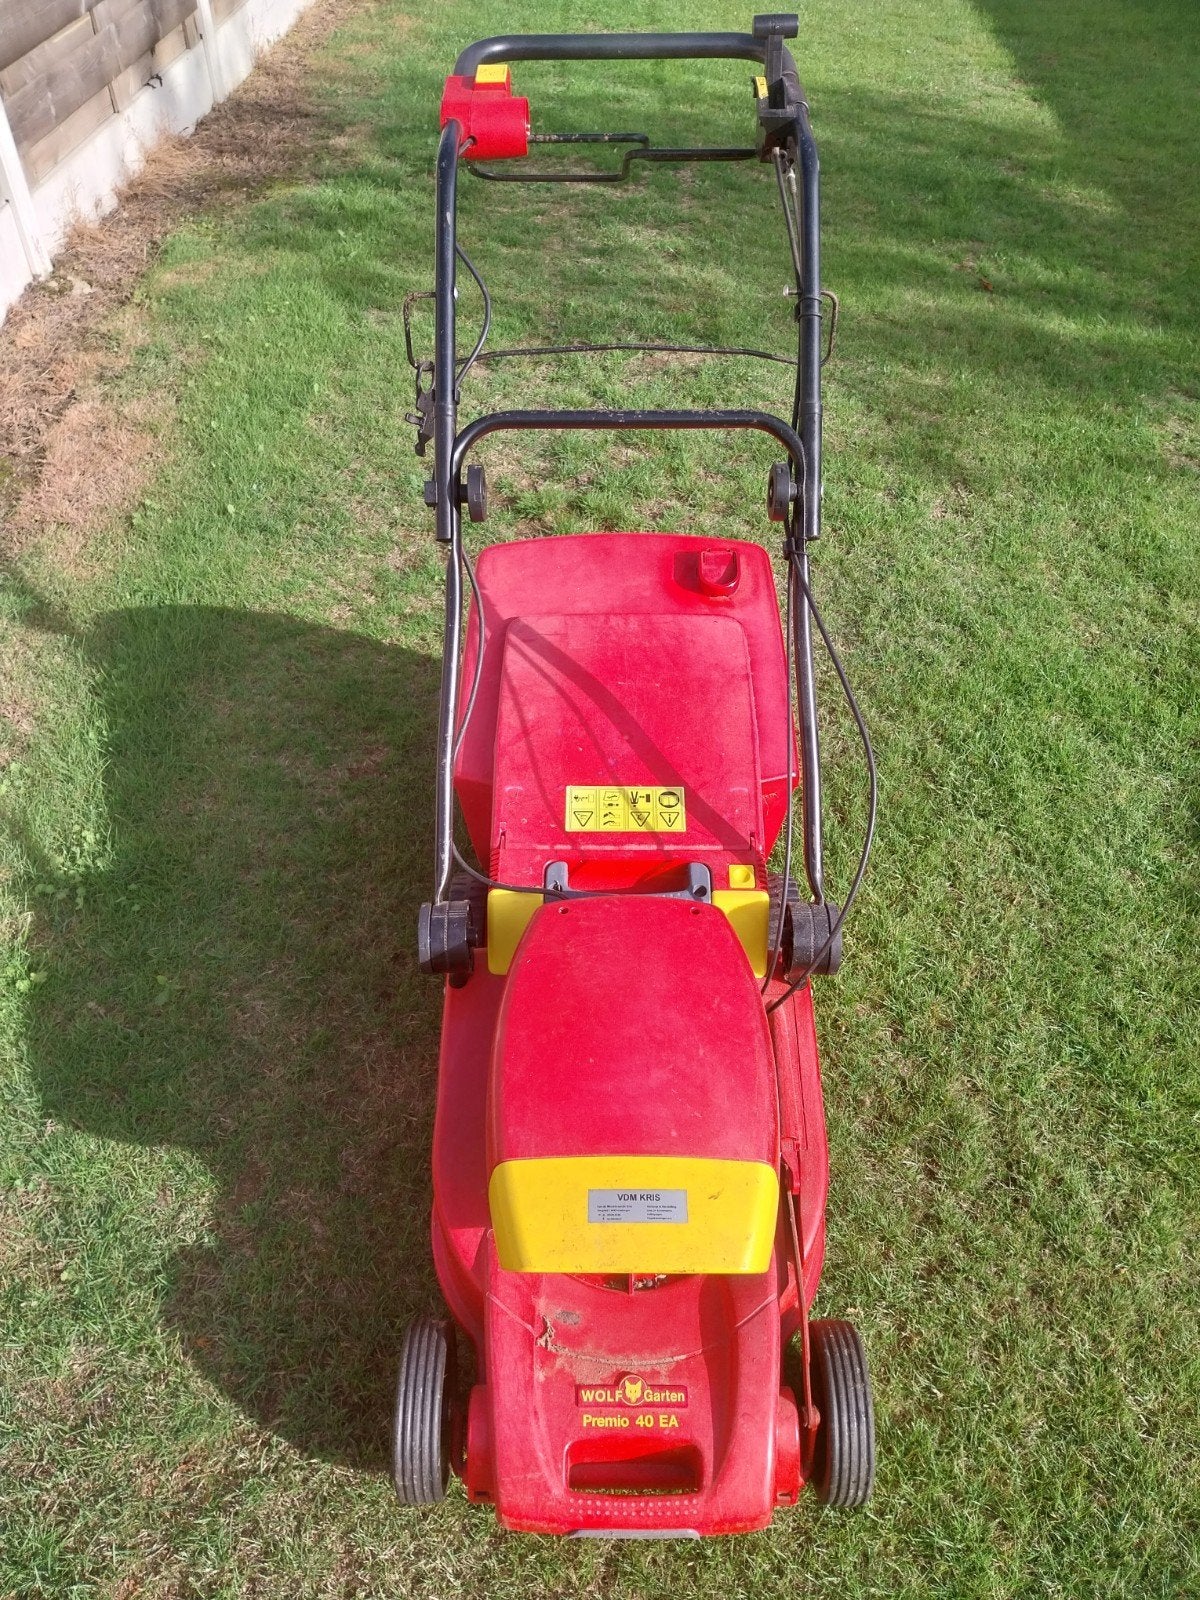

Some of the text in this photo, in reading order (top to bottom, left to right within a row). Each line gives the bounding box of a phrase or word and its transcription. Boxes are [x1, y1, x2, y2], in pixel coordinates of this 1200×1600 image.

[617, 1193, 661, 1201] VDM KRIS
[581, 1389, 685, 1402] WOLF Garten
[582, 1414, 679, 1428] Premio 40 EA
